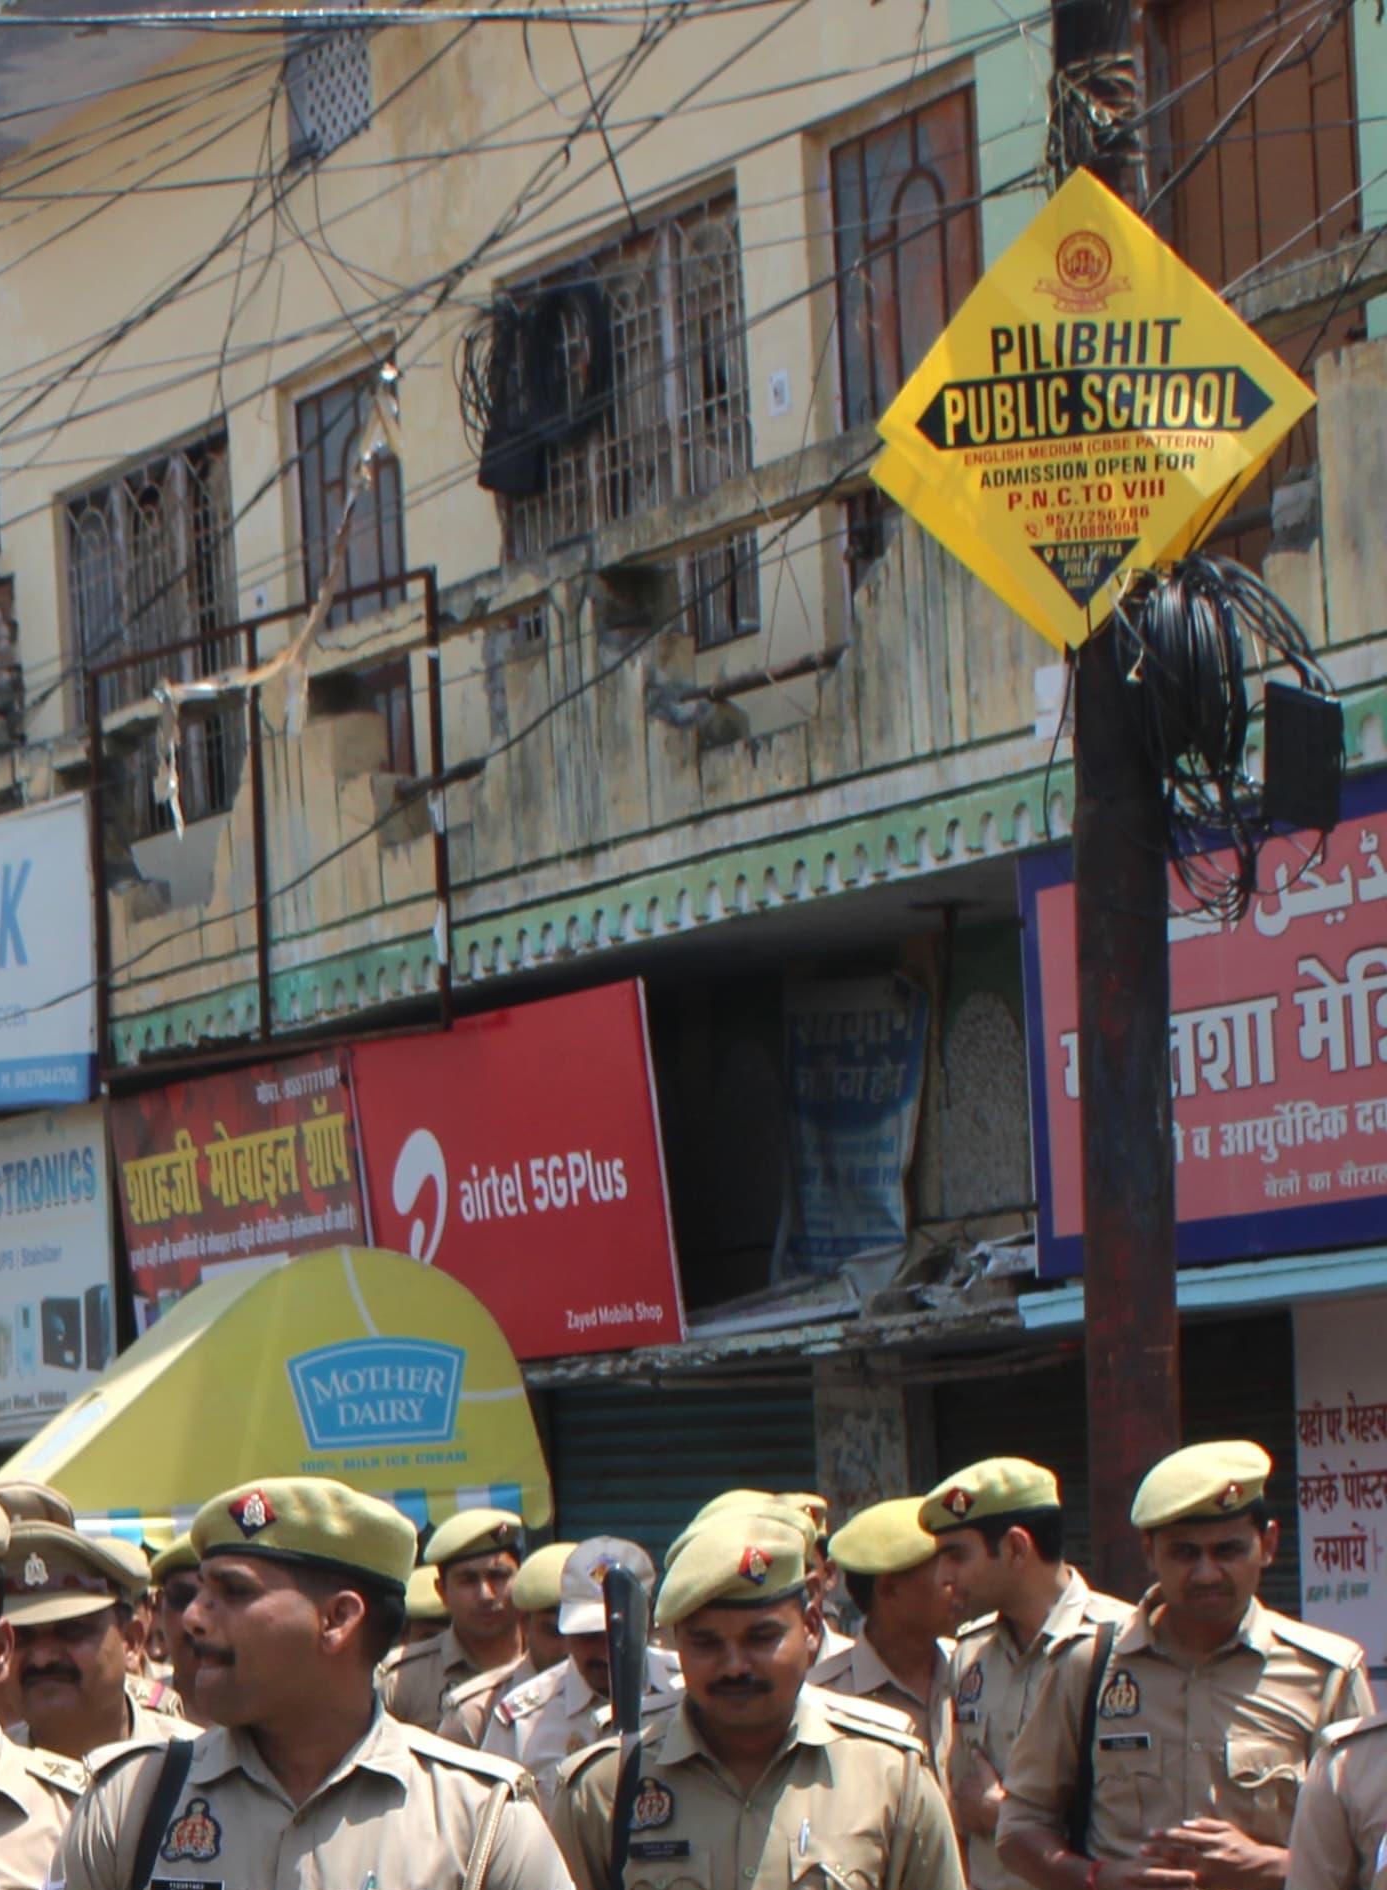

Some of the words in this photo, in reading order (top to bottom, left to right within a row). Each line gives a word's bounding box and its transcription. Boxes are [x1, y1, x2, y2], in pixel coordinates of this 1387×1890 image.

[990, 317, 1181, 374] PILIBHIT
[943, 376, 1070, 447] PUBLIC
[1081, 371, 1243, 432] SCHOOL
[964, 448, 1024, 466] ENGLISH
[1028, 441, 1084, 459] MEDIUM
[1087, 438, 1132, 457] (CBSE
[1135, 434, 1215, 450] PATTERN)
[980, 461, 1088, 489] ADMISSION
[1095, 455, 1147, 477] OPEN
[1155, 452, 1196, 472] FOR
[1123, 478, 1165, 499] VIII
[1192, 1126, 1211, 1159] व
[1219, 1100, 1348, 1163] आयुर्वेदिक
[122, 1128, 202, 1225] शाहजी
[205, 1121, 300, 1208] मोबाइल
[301, 1096, 351, 1190] शॉप
[459, 1162, 528, 1223] airtel
[1307, 1172, 1331, 1194] का
[599, 1303, 634, 1326] Mobile
[635, 1301, 663, 1324] Shop
[337, 1398, 426, 1428] DAIRY
